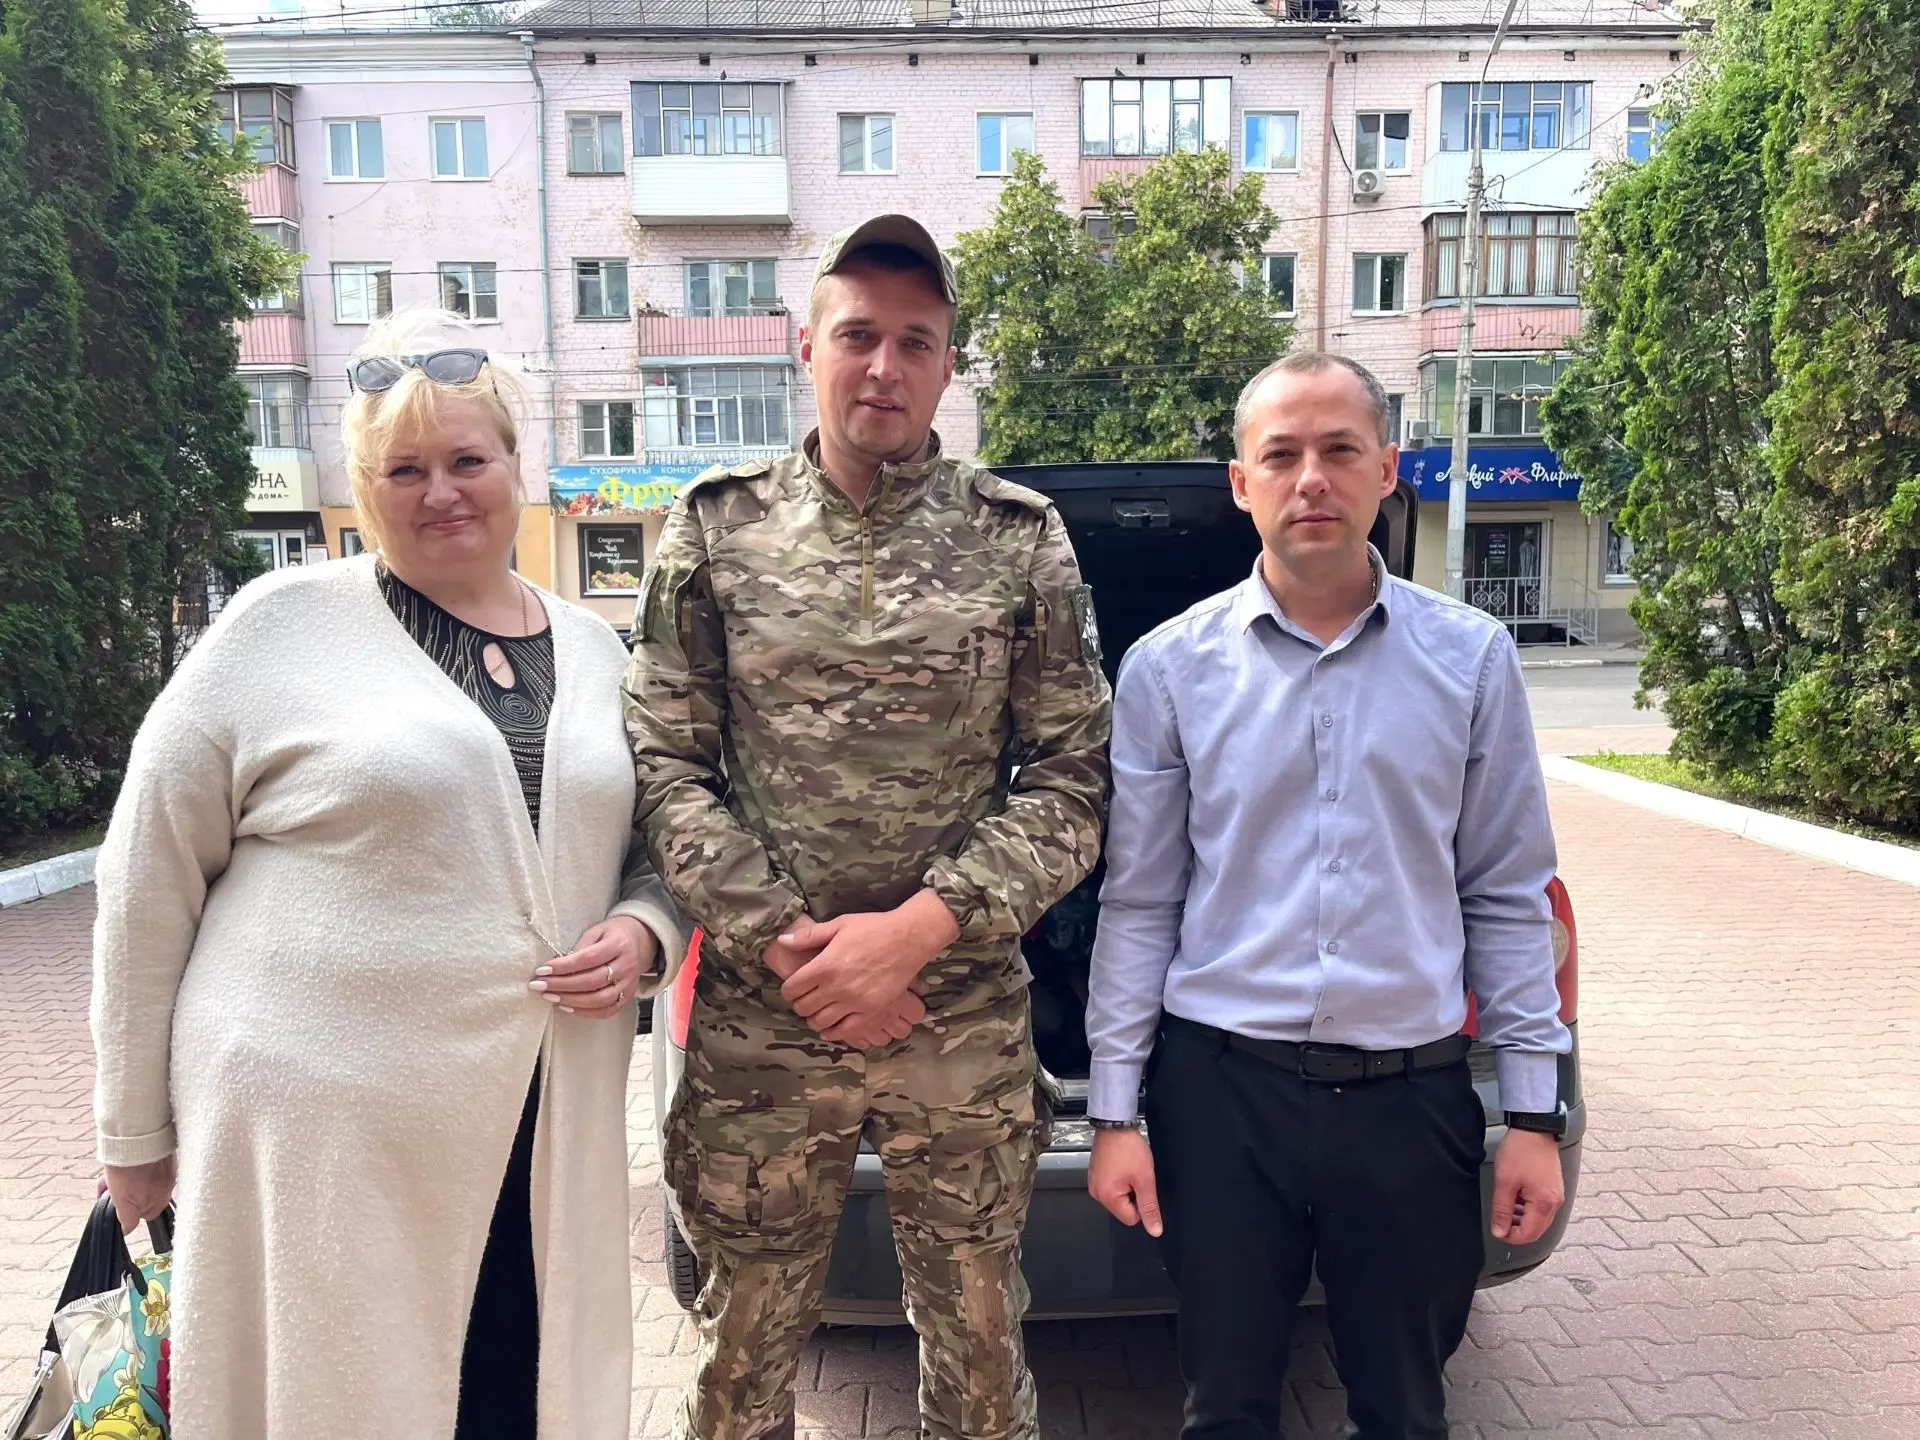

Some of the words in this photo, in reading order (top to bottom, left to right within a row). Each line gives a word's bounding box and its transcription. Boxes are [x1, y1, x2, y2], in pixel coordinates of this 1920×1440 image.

[589, 466, 651, 475] СУХОФРУКТЫ
[1435, 463, 1495, 490] Лкий
[258, 493, 282, 501] ДОМА
